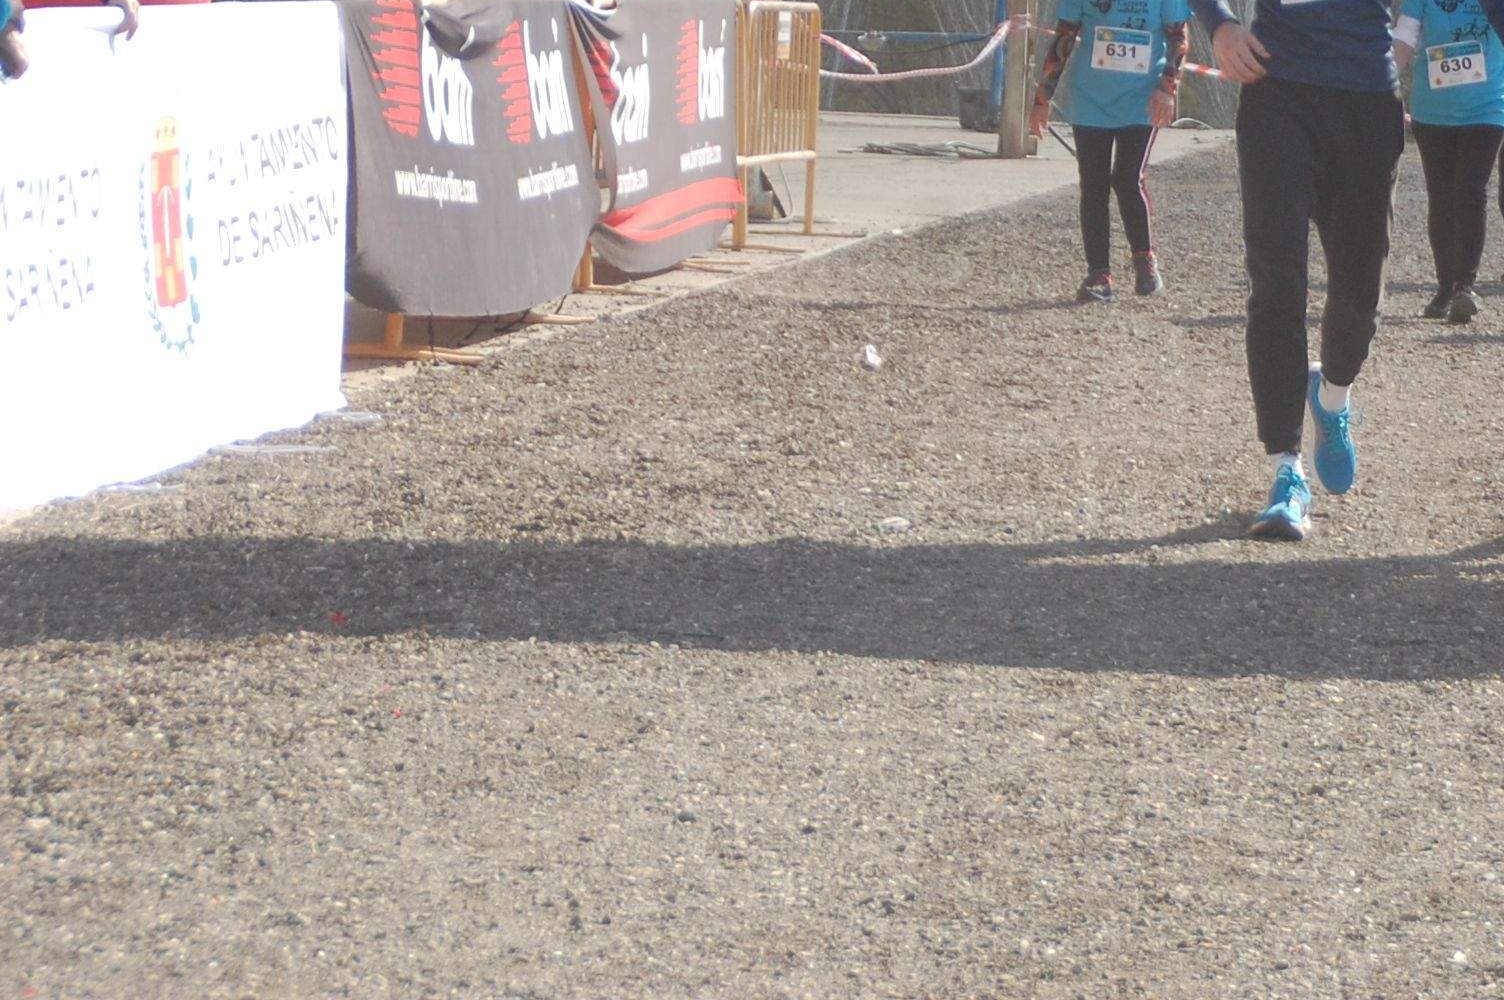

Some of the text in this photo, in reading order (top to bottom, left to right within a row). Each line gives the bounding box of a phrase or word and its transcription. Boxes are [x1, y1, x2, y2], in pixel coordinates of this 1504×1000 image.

[1105, 42, 1137, 59] 631
[1440, 56, 1472, 74] 630
[523, 19, 574, 140] barri
[218, 216, 245, 267] DE
